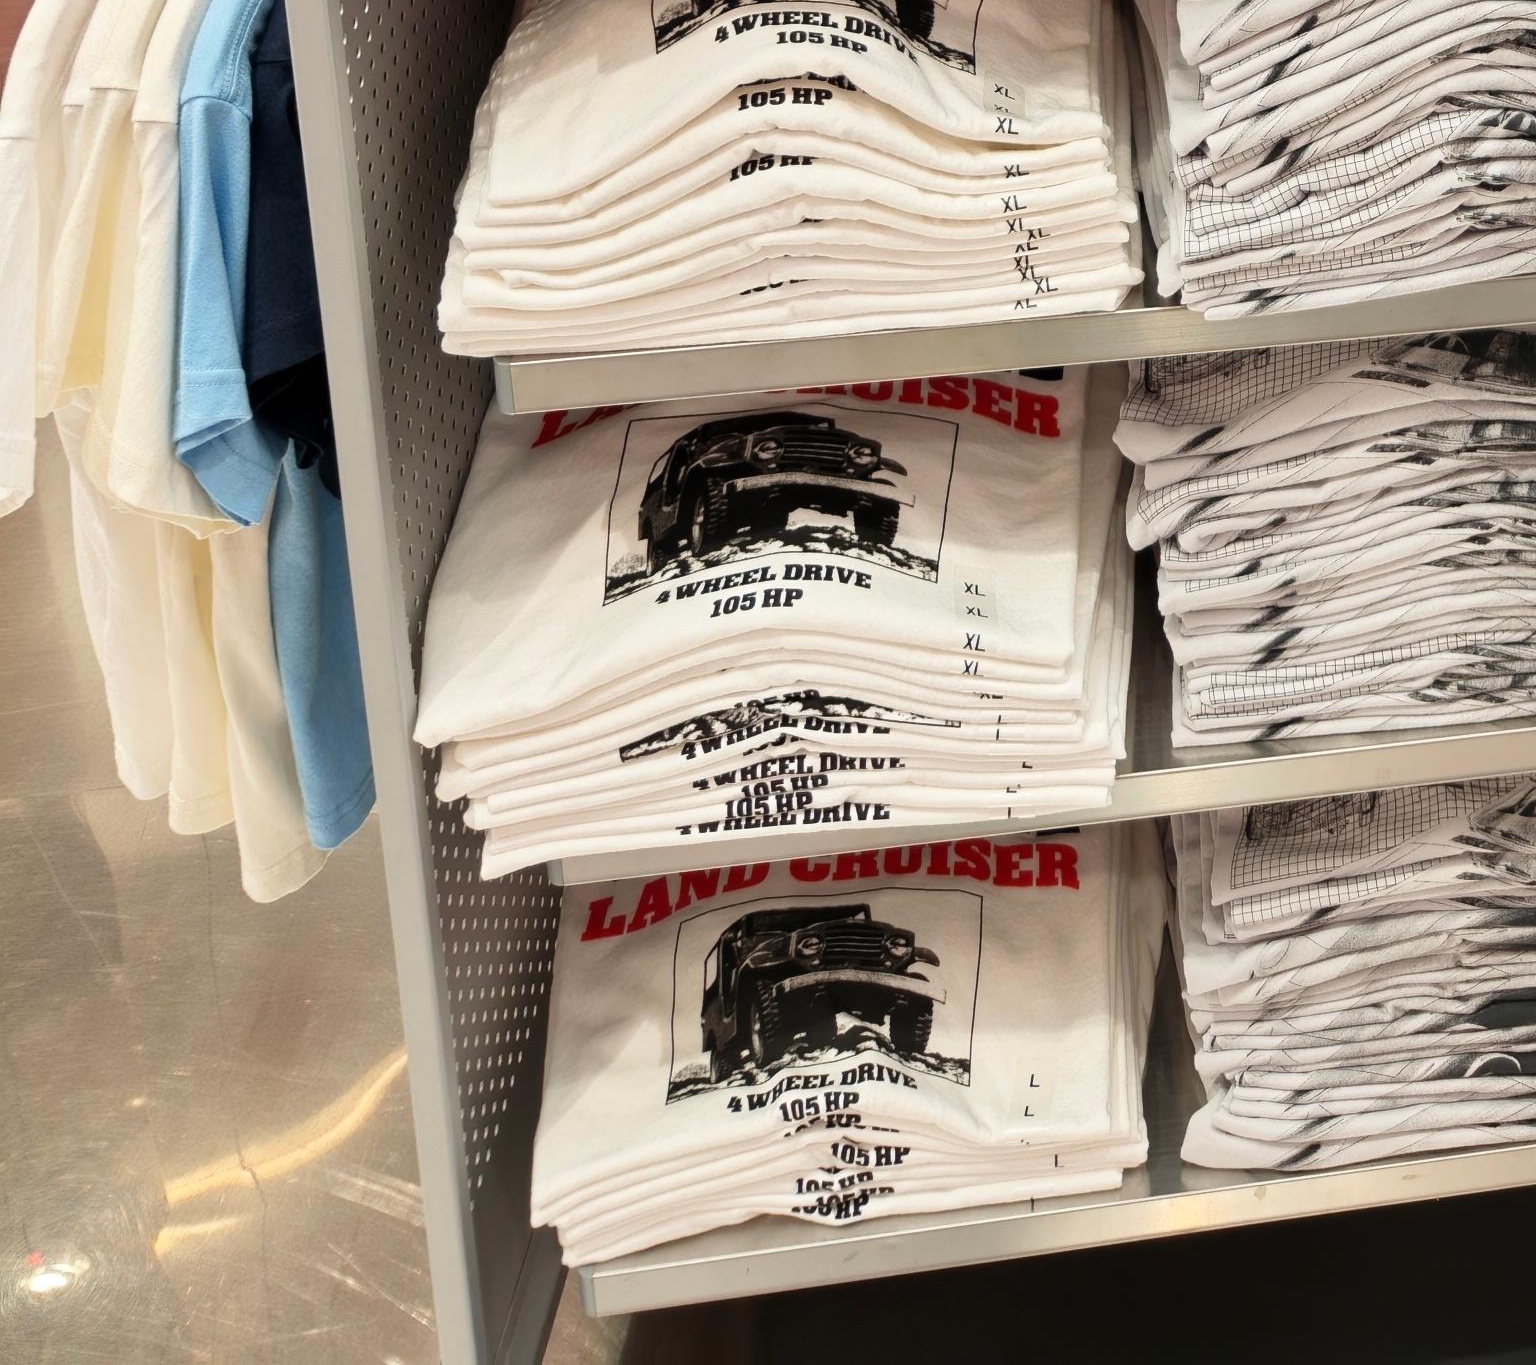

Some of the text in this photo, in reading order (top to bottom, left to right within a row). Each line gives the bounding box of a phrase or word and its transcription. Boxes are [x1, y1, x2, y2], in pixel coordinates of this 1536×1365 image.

[714, 11, 838, 45] 4 WHEEL
[775, 29, 869, 55] 105 HP
[737, 87, 833, 111] 105 HP
[993, 83, 1016, 101] XL
[995, 116, 1019, 135] XL
[1003, 163, 1029, 179] XL
[1000, 194, 1027, 214] XL
[1034, 277, 1059, 295] XL
[655, 563, 872, 605] 4 WHEEL DRIVE
[964, 582, 986, 597] XL
[710, 587, 805, 618] 105 HP
[966, 605, 989, 618] XL
[962, 632, 986, 652] XL
[725, 791, 814, 819] 105 HP
[579, 839, 1081, 943] LAND CRUISER
[727, 1063, 918, 1113] 4 WHEEL DRIVE
[1029, 1073, 1040, 1088] L
[779, 1091, 860, 1123] 105 HP
[1024, 1105, 1035, 1117] L
[831, 1142, 912, 1167] 105 HP
